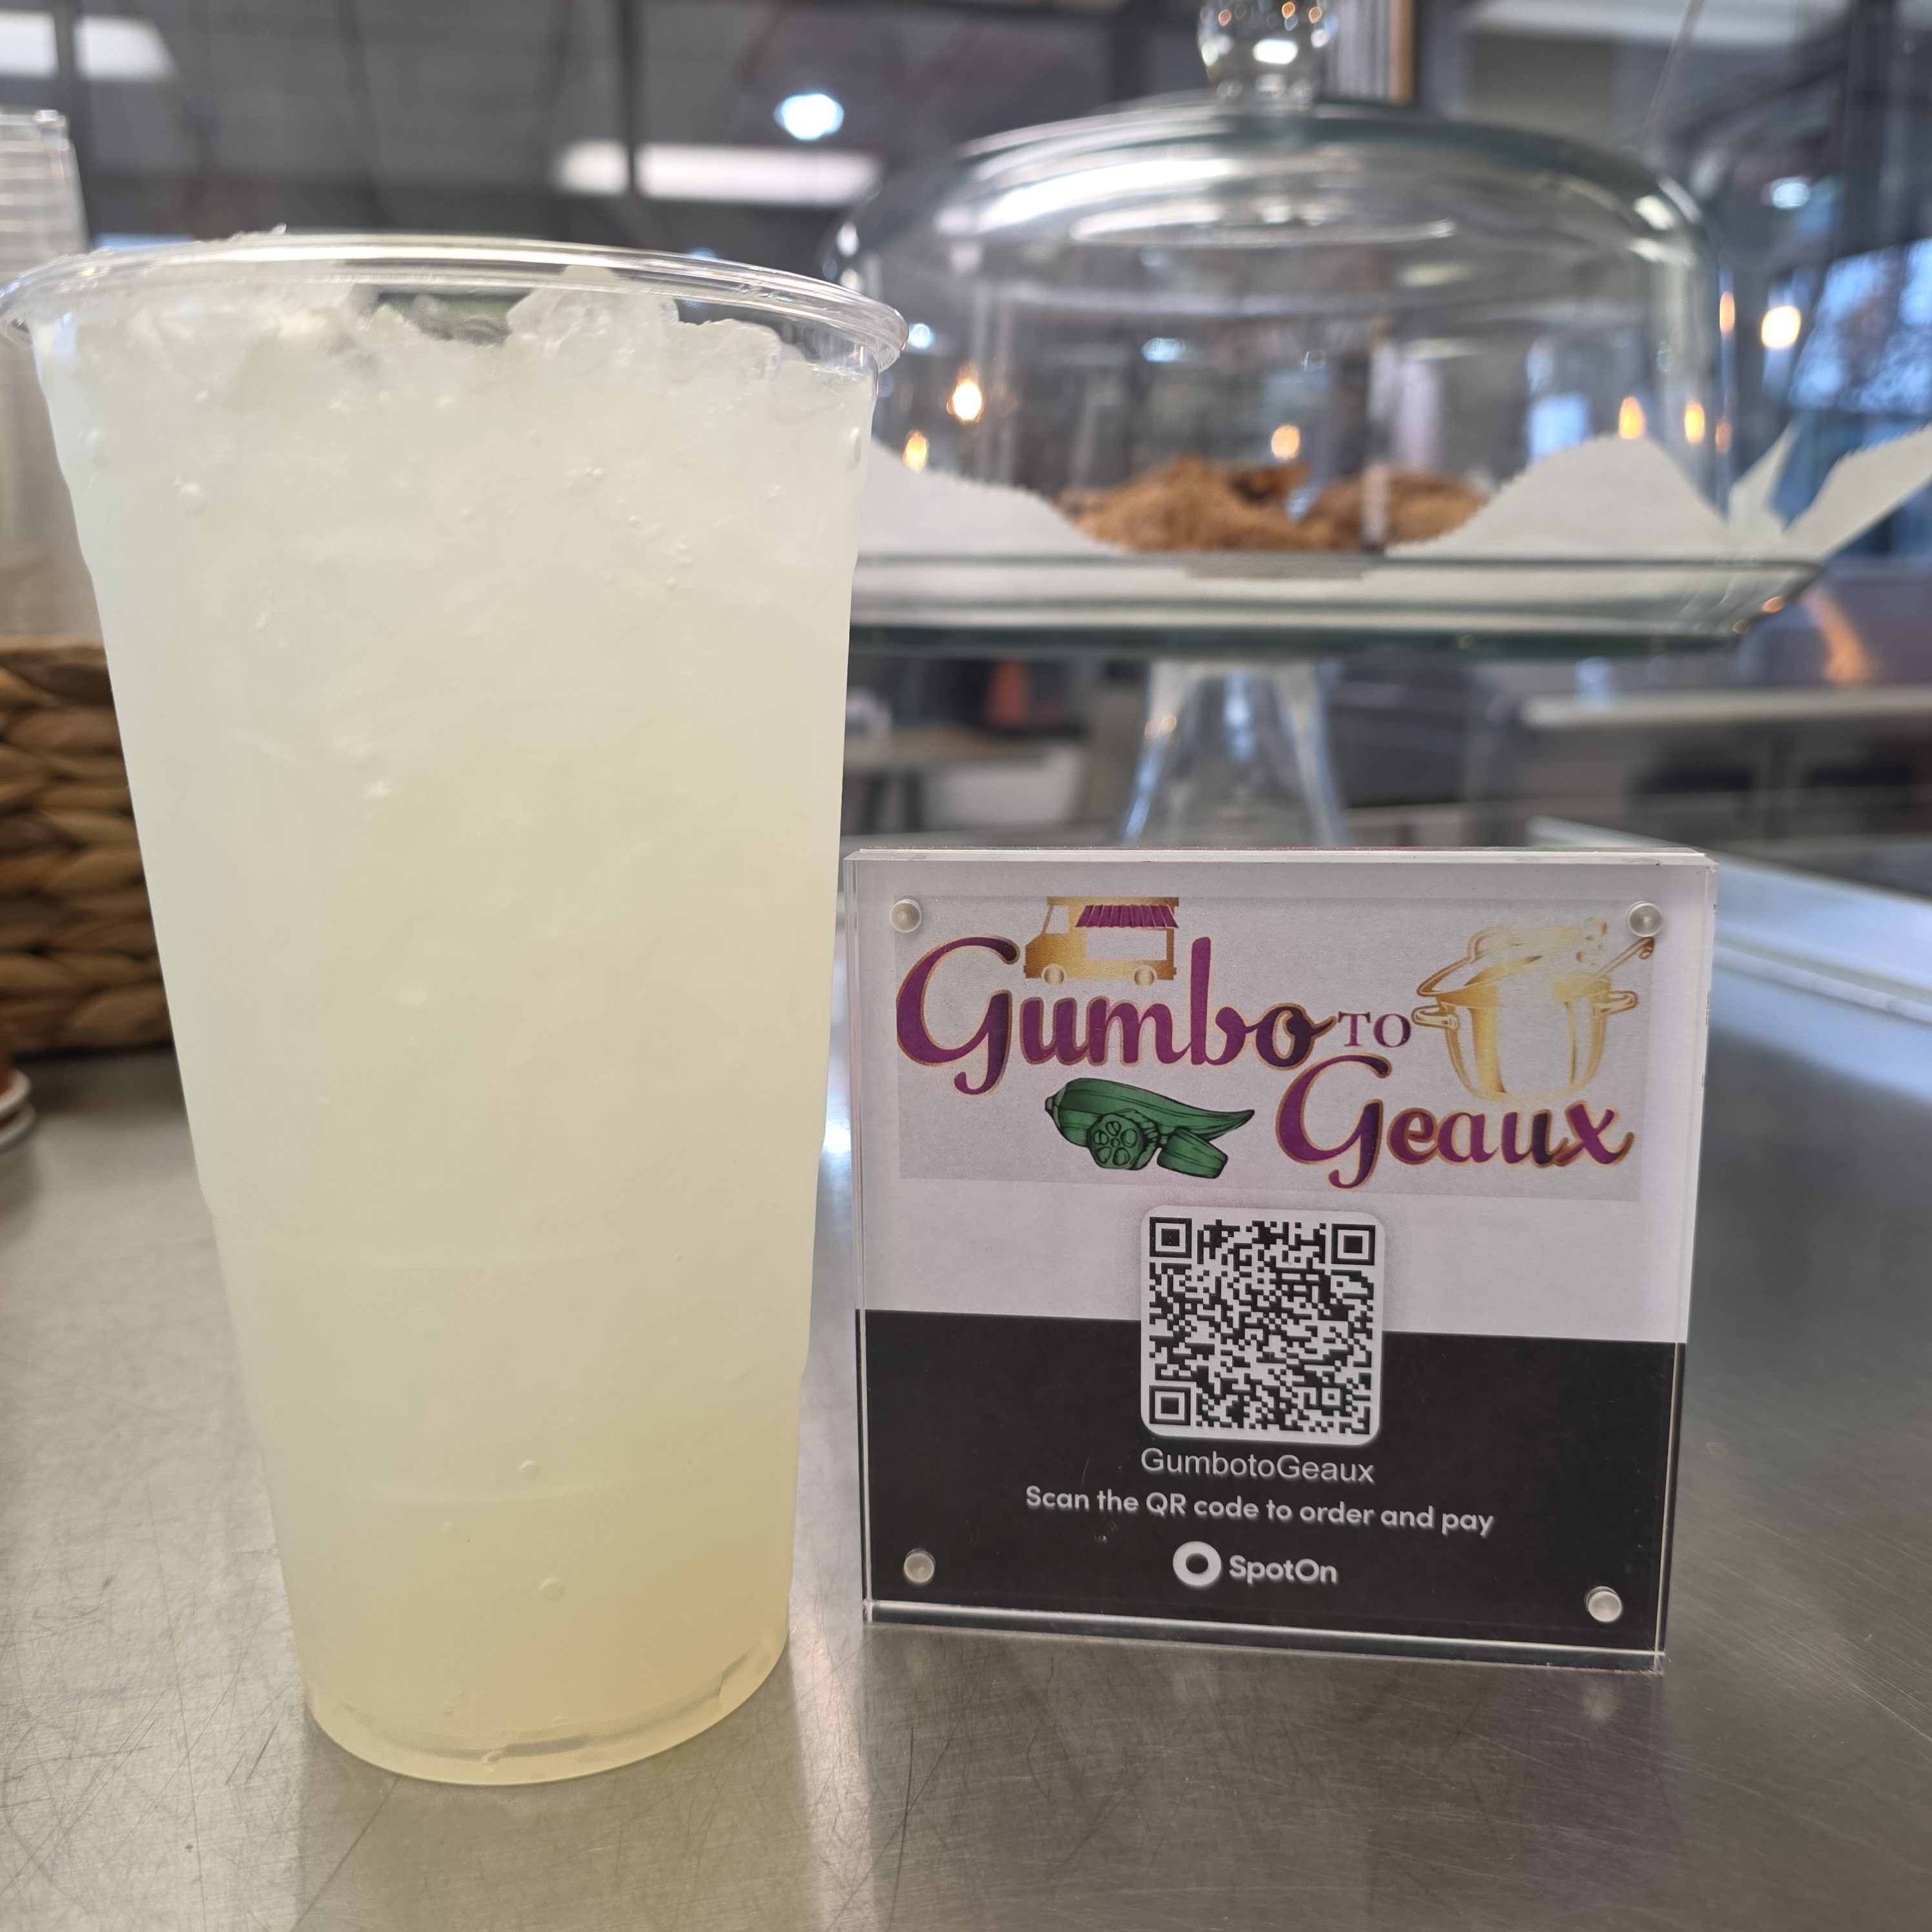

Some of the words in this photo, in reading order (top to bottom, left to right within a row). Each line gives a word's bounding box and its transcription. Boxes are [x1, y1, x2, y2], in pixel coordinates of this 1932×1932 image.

[895, 935, 1336, 1095] Gumbo
[1337, 1011, 1412, 1048] TO
[1275, 1052, 1634, 1190] Geaux
[1140, 1448, 1375, 1483] GumbotoGeaux
[1025, 1486, 1090, 1510] Scan
[1097, 1490, 1138, 1513] the
[1146, 1492, 1186, 1517] QR
[1193, 1495, 1259, 1519] code
[1266, 1499, 1292, 1521] to
[1299, 1501, 1375, 1525] order
[1380, 1505, 1434, 1529] and
[1441, 1512, 1494, 1537] pay
[1229, 1555, 1339, 1585] SpotOn
